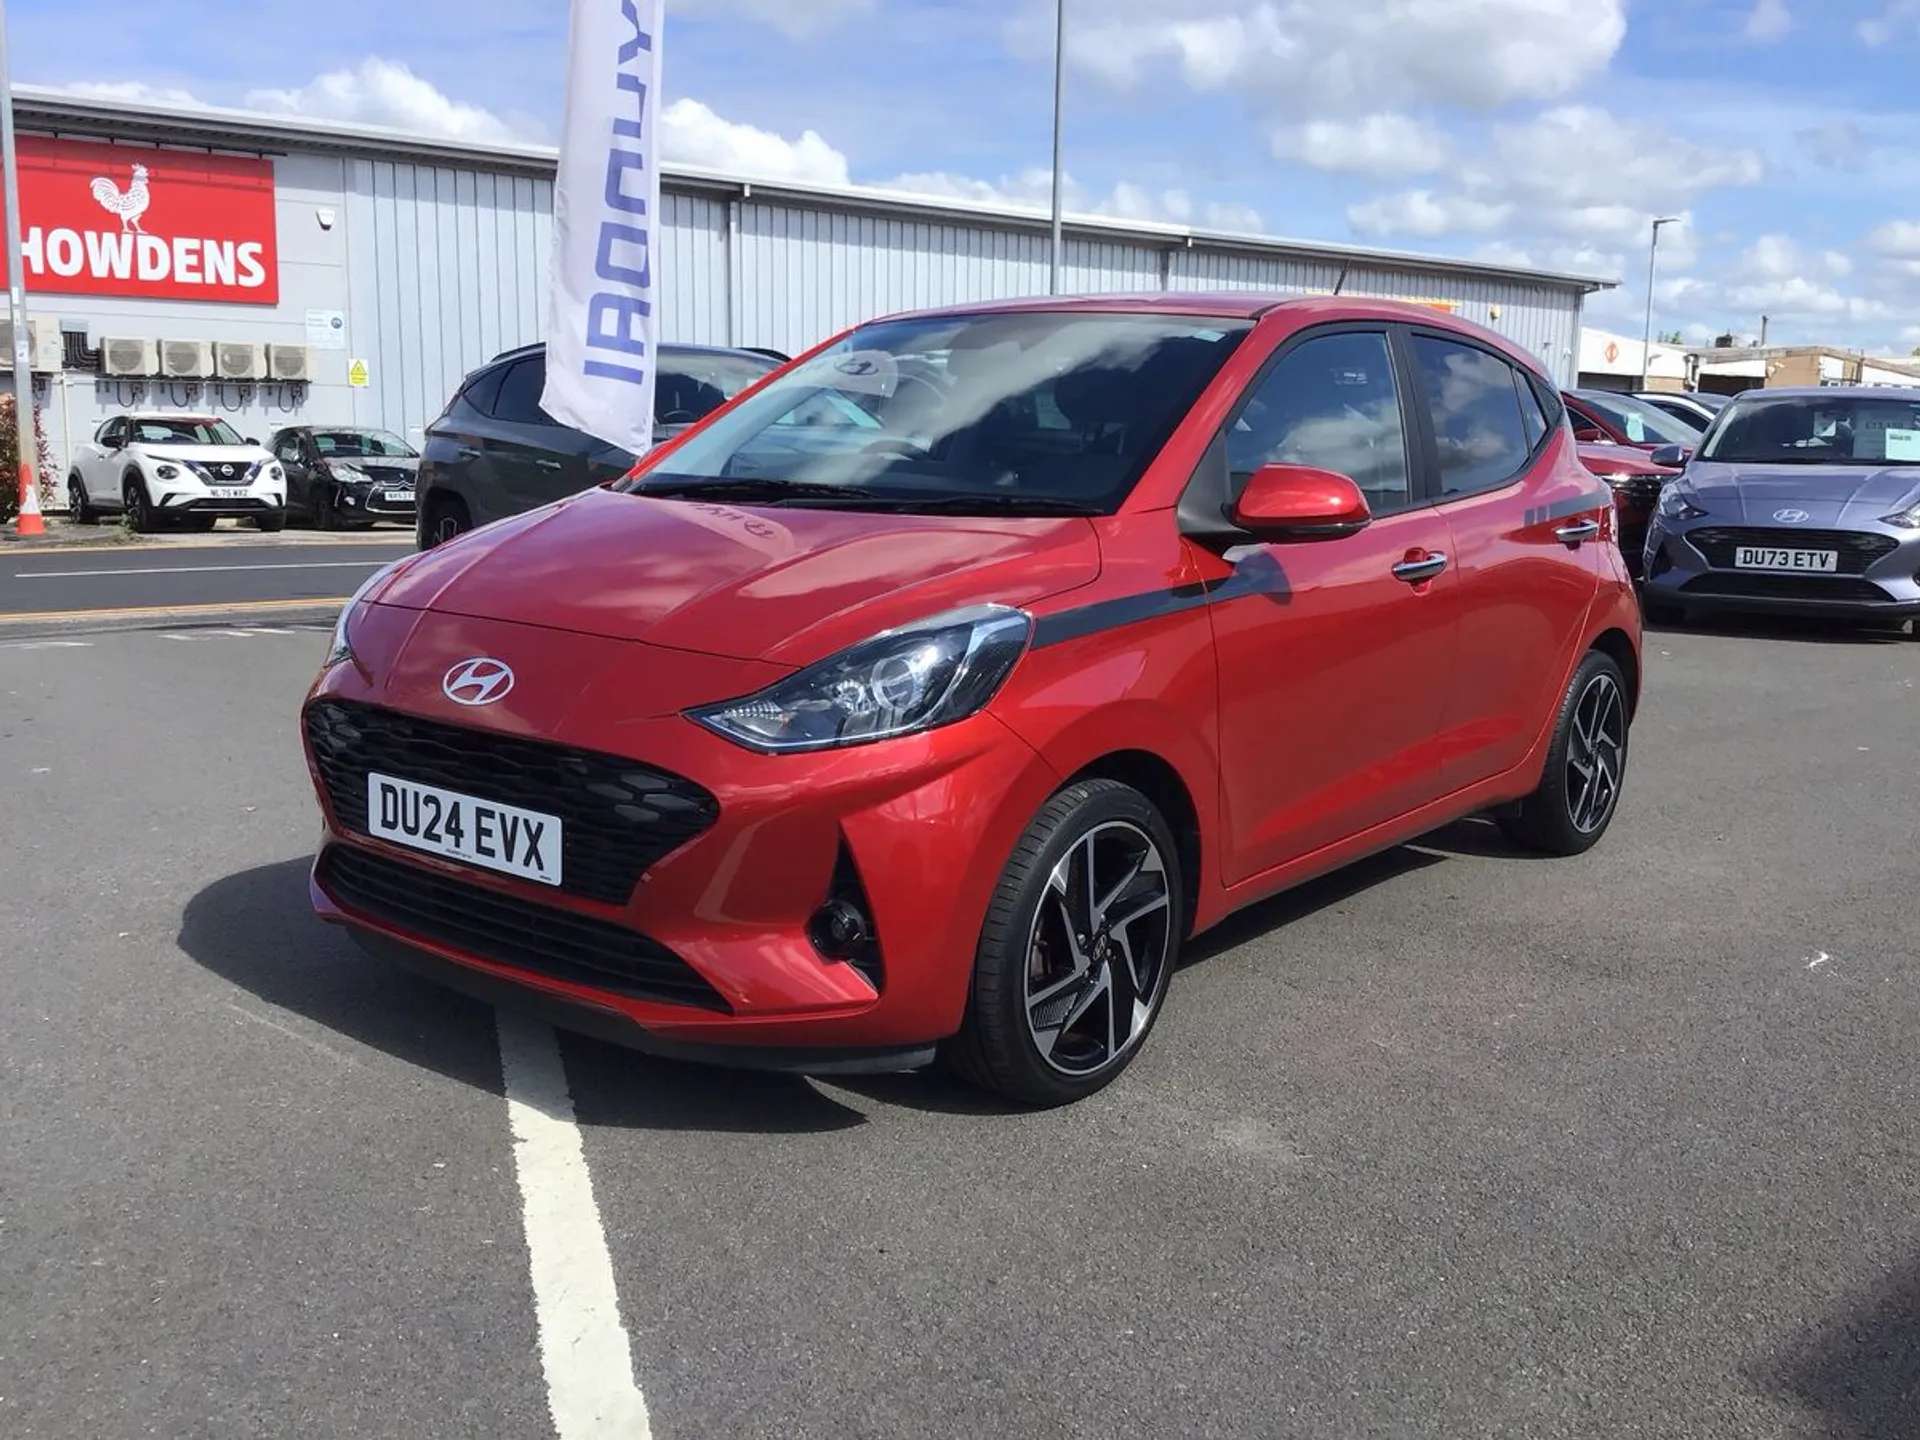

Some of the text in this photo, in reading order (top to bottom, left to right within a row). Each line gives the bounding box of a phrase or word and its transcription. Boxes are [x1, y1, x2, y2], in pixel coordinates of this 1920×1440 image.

[21, 226, 266, 288] HOWDENS
[1742, 549, 1830, 568] DU73 ETV
[380, 782, 544, 871] DU24 EVX
